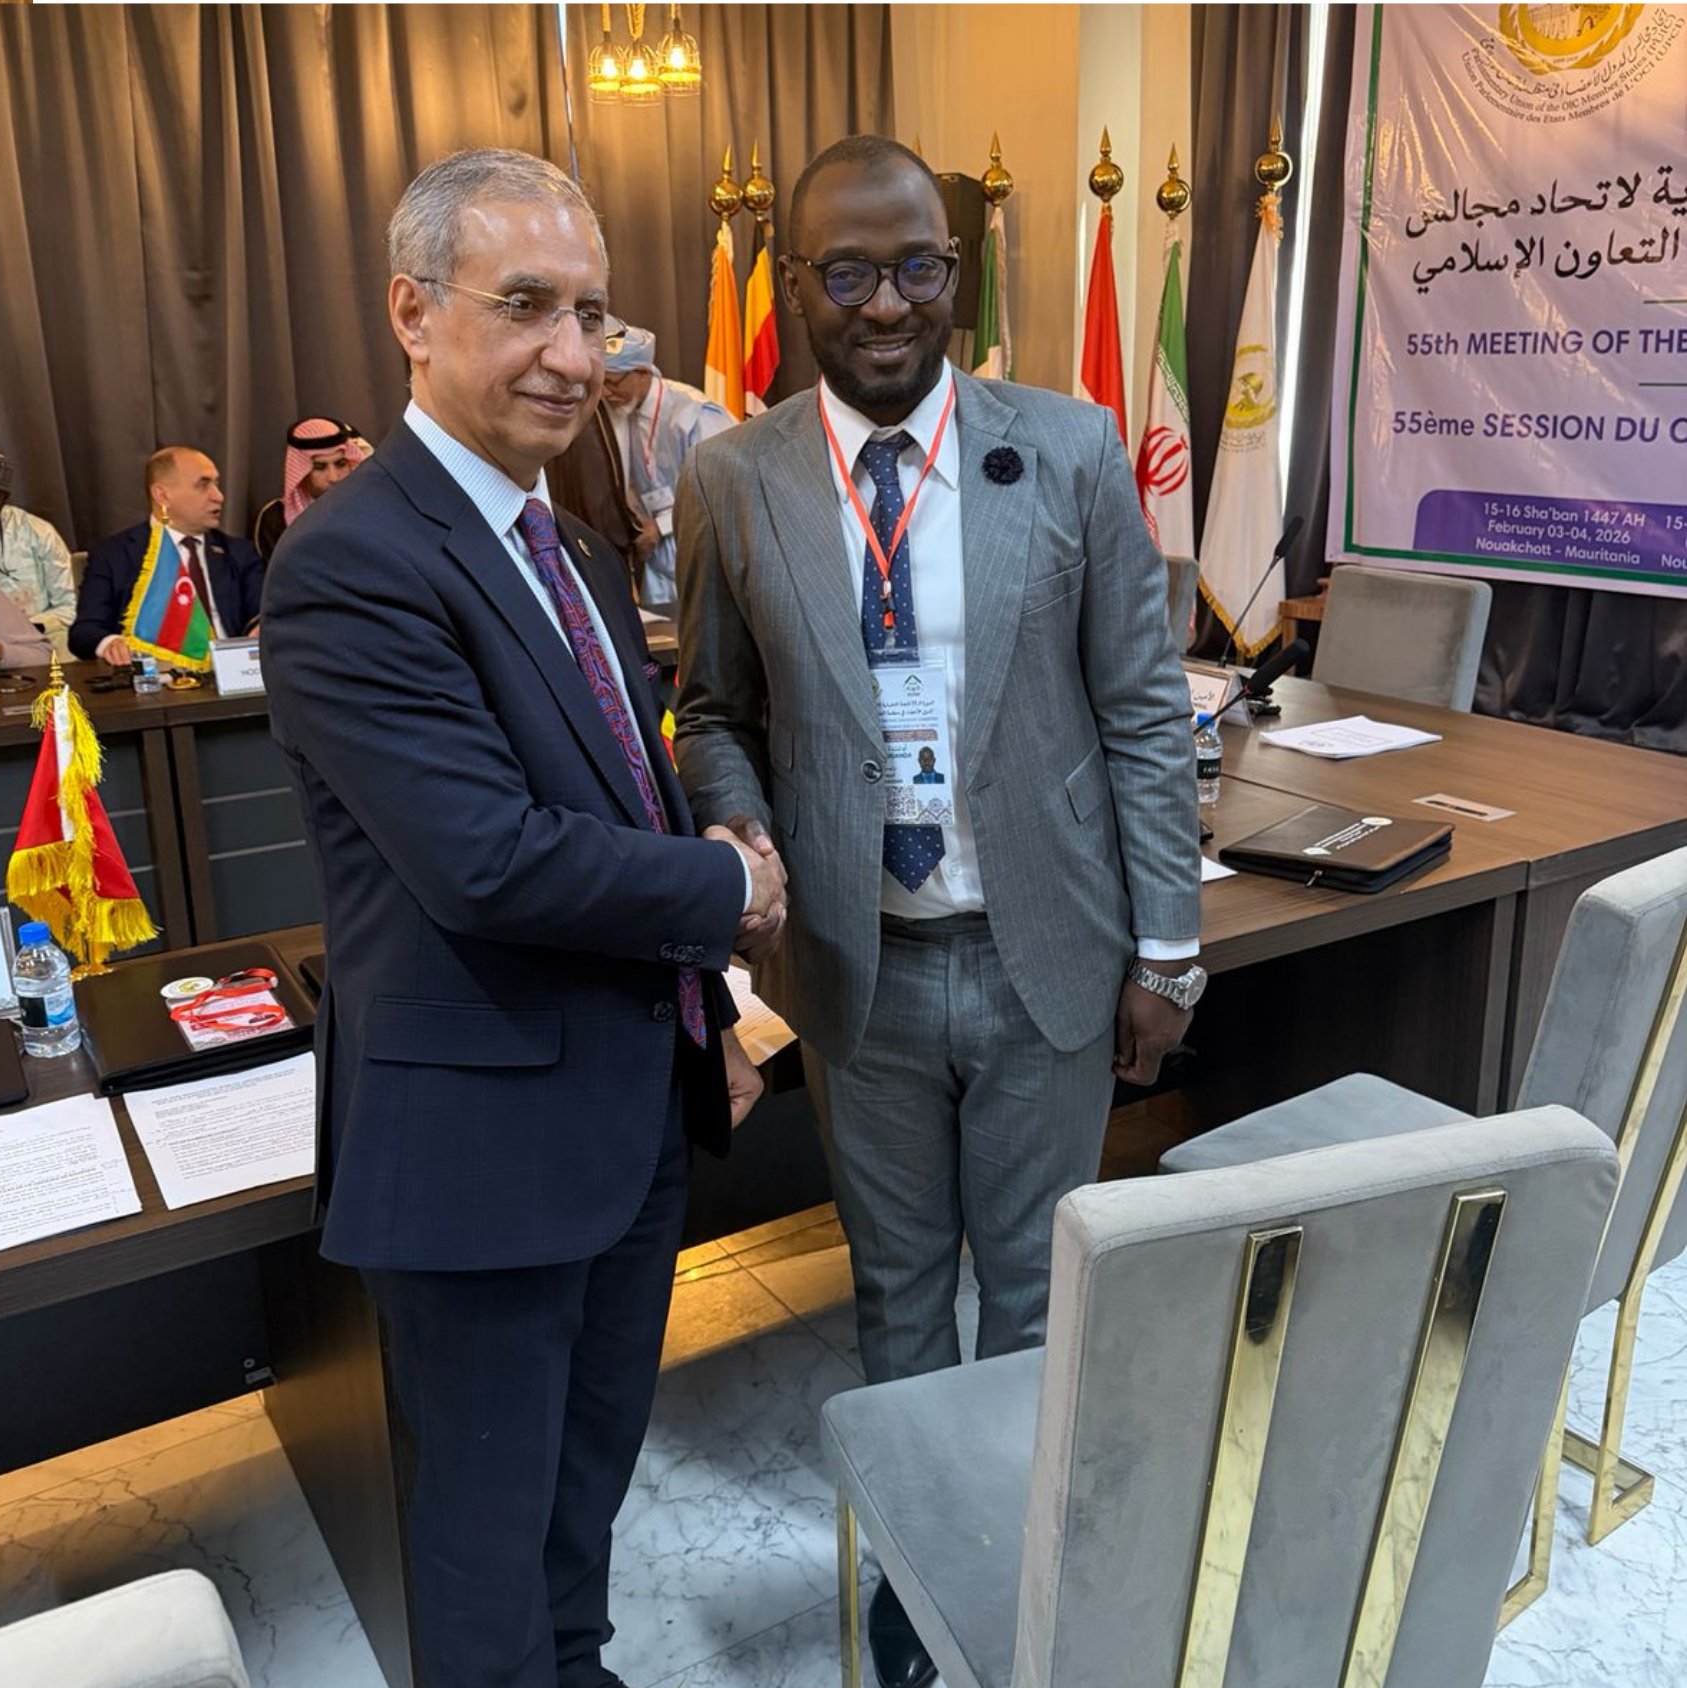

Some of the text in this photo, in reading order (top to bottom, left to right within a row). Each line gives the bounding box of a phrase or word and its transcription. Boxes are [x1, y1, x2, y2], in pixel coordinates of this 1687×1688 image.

[1530, 172, 1642, 216] لاتحاد
[1413, 226, 1680, 294] التعاون الإسلامي
[1407, 333, 1458, 356] 55th
[1467, 330, 1583, 355] MEETING
[1592, 330, 1630, 354] OF
[1392, 410, 1475, 436] 55ème
[1483, 413, 1605, 441] SESSION
[1615, 416, 1659, 443] DU
[1484, 502, 1521, 517] 15-16
[1584, 510, 1620, 524] 1447
[1622, 513, 1646, 527] AH
[1488, 519, 1631, 544] February 03-04, 2026
[1475, 537, 1552, 556] Nouakchott
[1565, 544, 1641, 565] Mauritania
